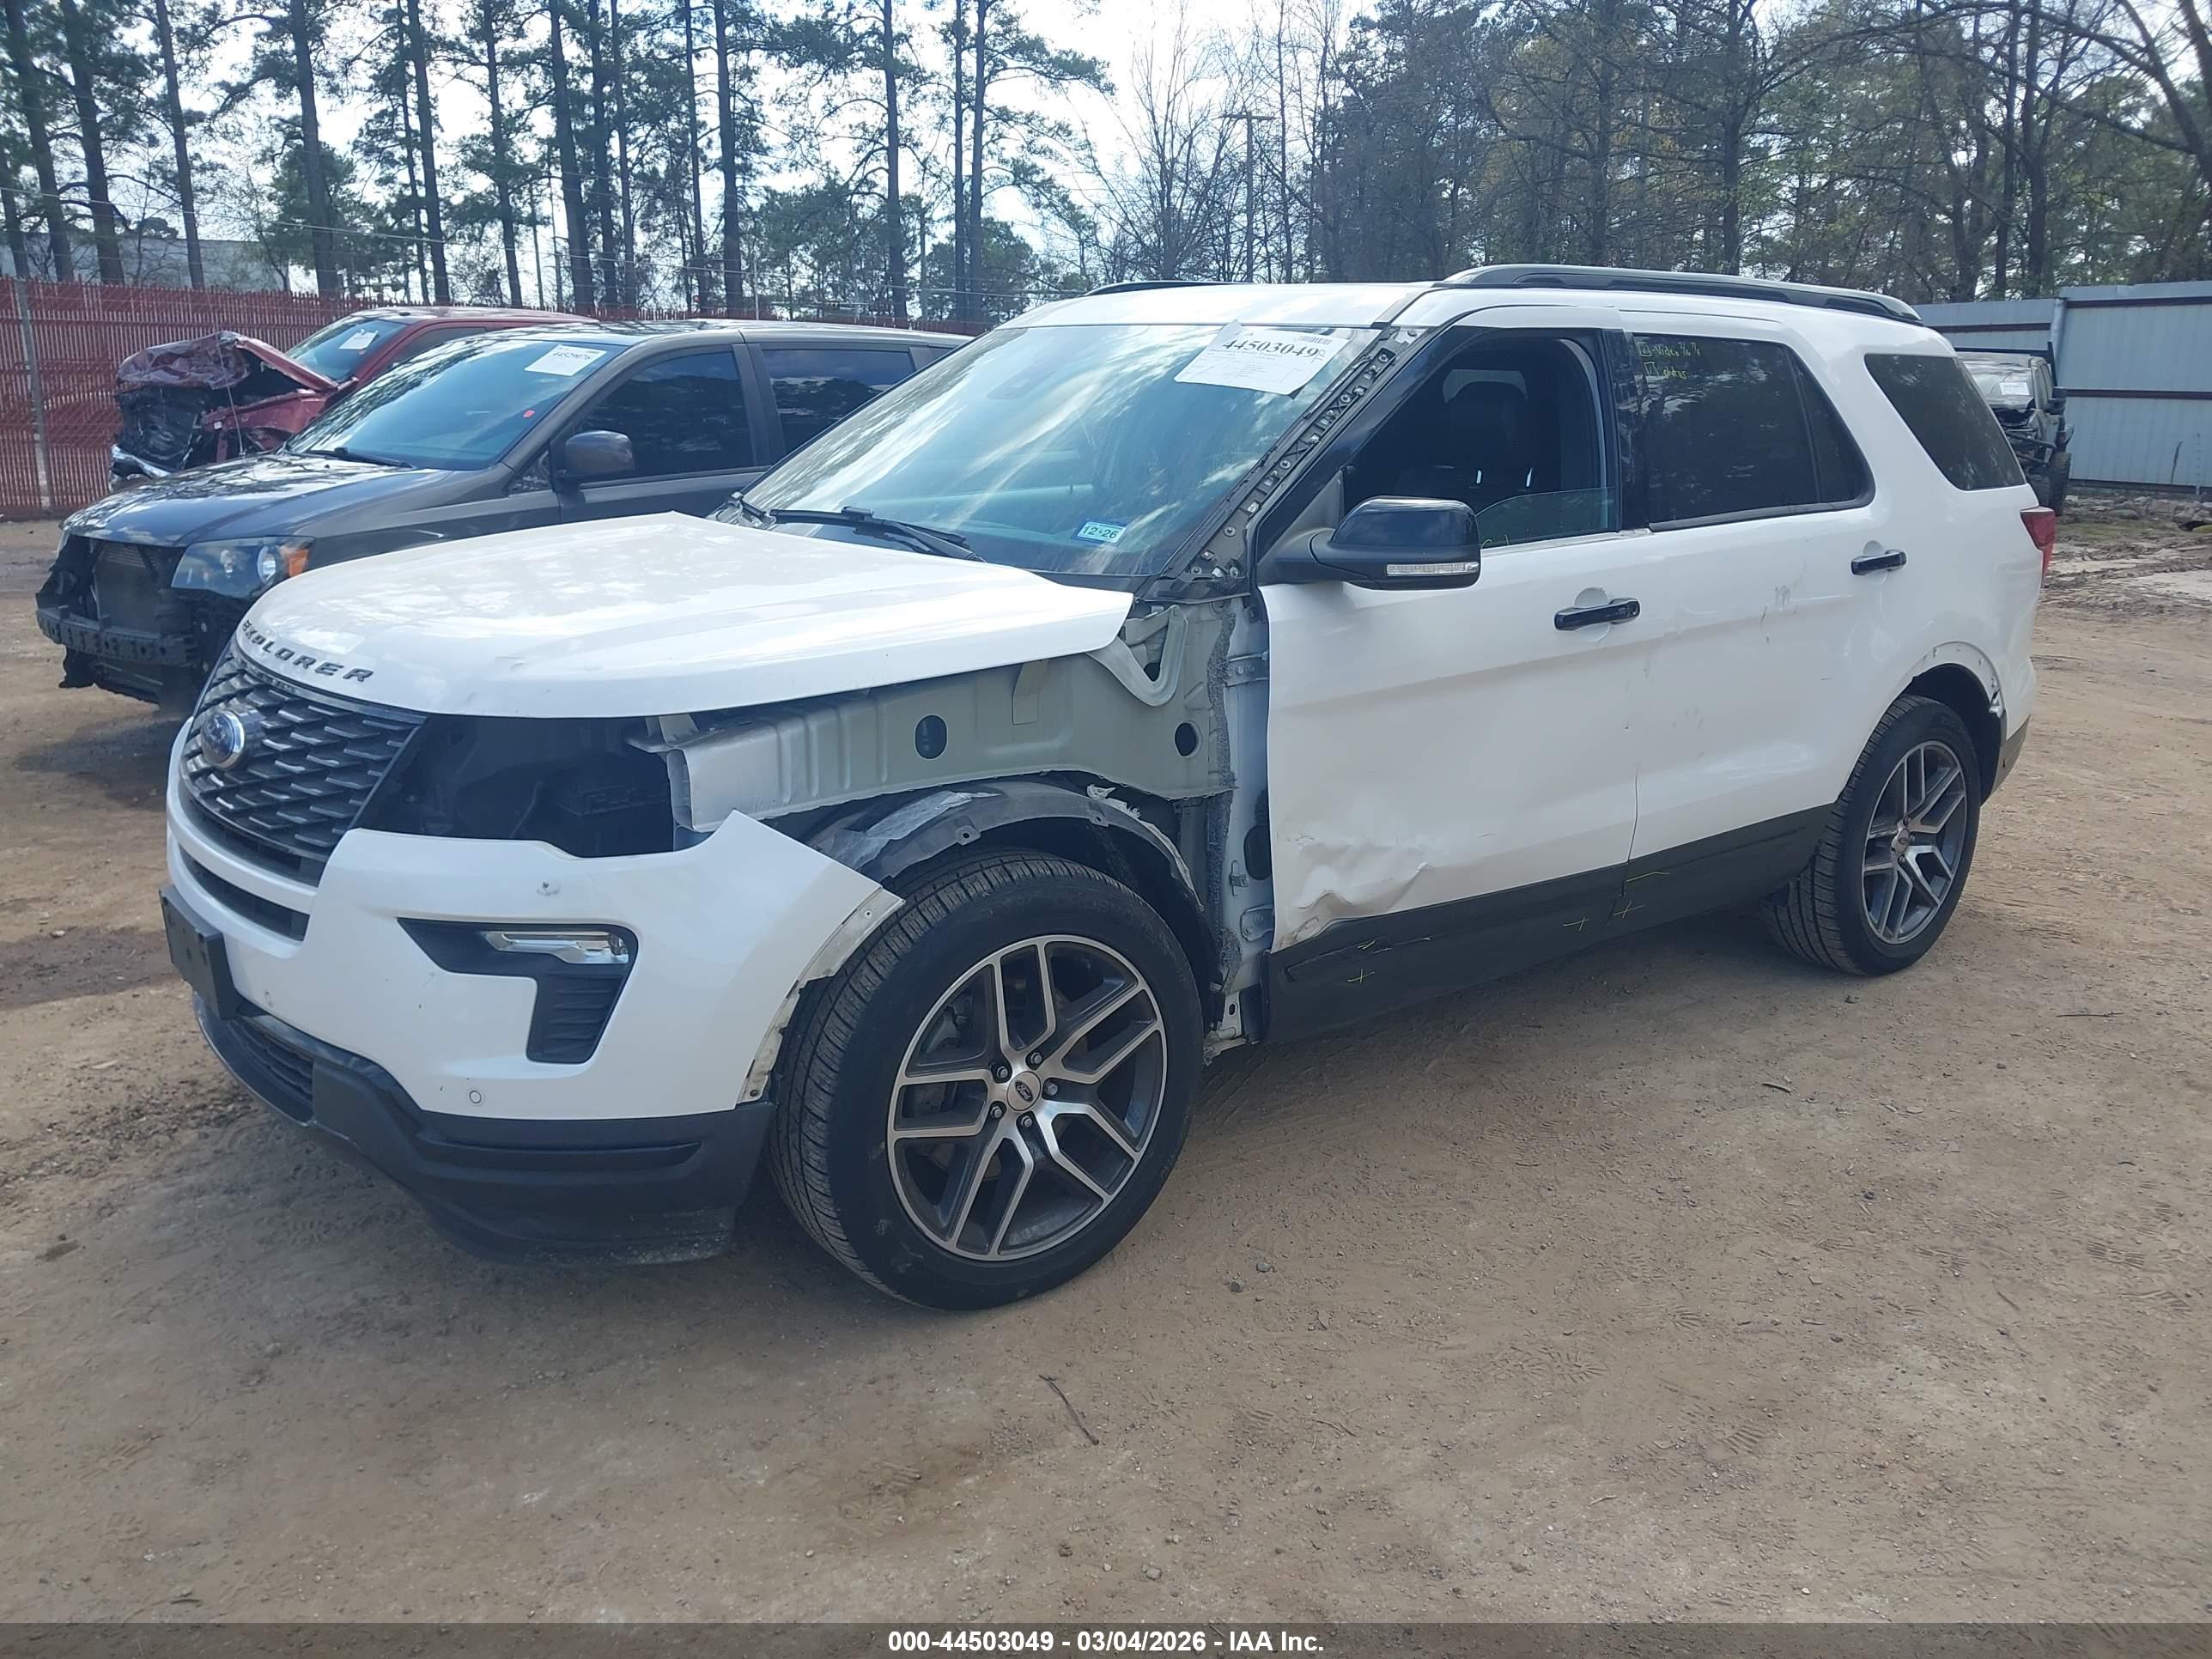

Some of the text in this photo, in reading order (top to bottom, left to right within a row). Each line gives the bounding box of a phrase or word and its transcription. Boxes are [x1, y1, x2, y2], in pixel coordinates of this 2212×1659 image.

[1223, 339, 1319, 358] 44503049
[1102, 529, 1119, 538] 26
[241, 619, 374, 684] EXPLORER
[1017, 1083, 1031, 1099] Ford
